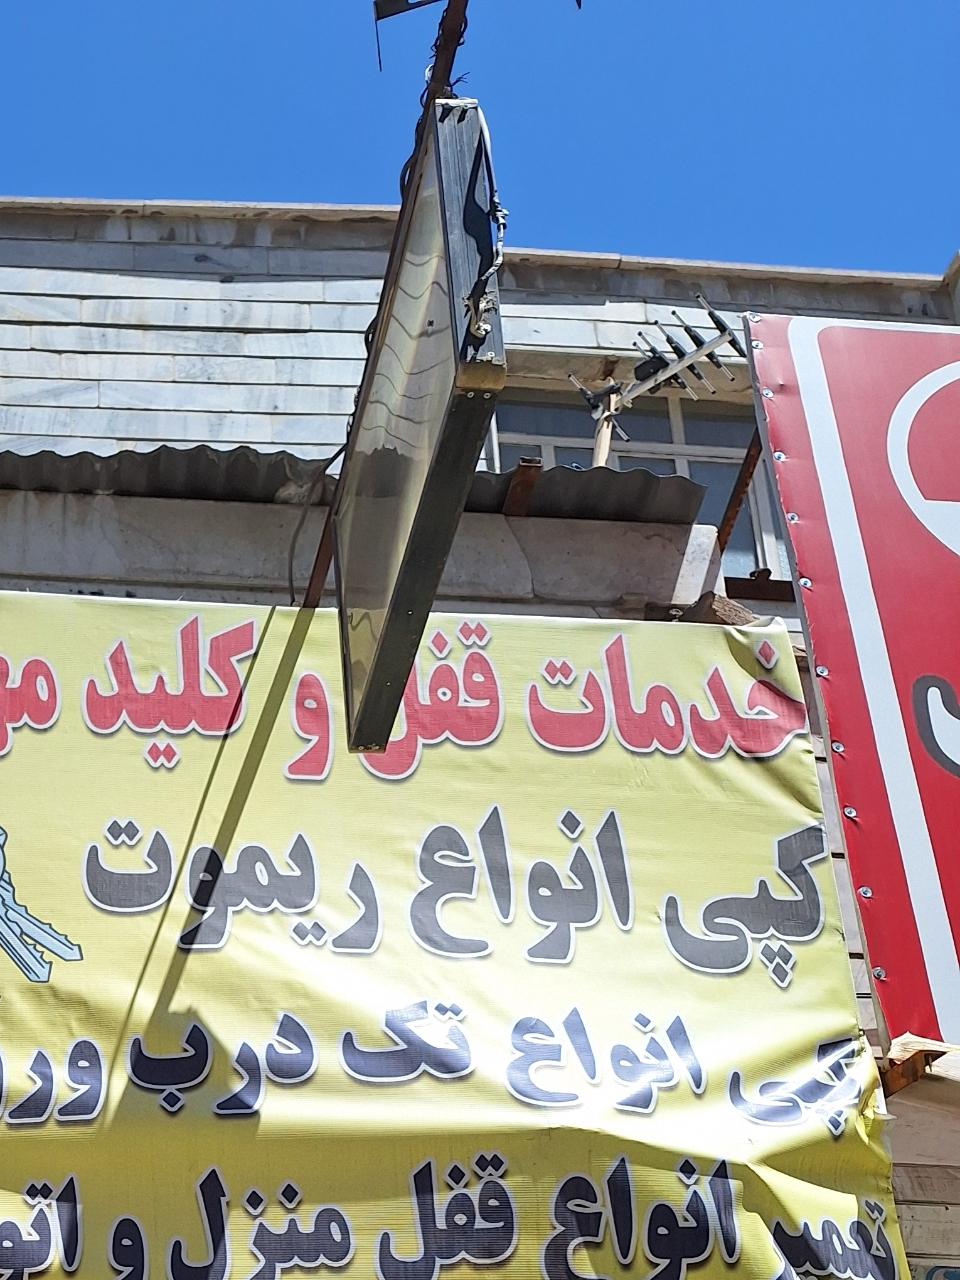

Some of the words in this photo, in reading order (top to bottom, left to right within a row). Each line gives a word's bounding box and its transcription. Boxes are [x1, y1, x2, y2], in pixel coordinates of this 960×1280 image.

[85, 616, 257, 767] کلید
[283, 672, 336, 779] و
[527, 632, 807, 757] خدمات
[82, 818, 383, 954] ریموت
[409, 805, 632, 963] انواع
[665, 824, 826, 988] کپی
[129, 1013, 315, 1114] درب
[342, 1000, 474, 1083] تک
[506, 1007, 707, 1113] انواع
